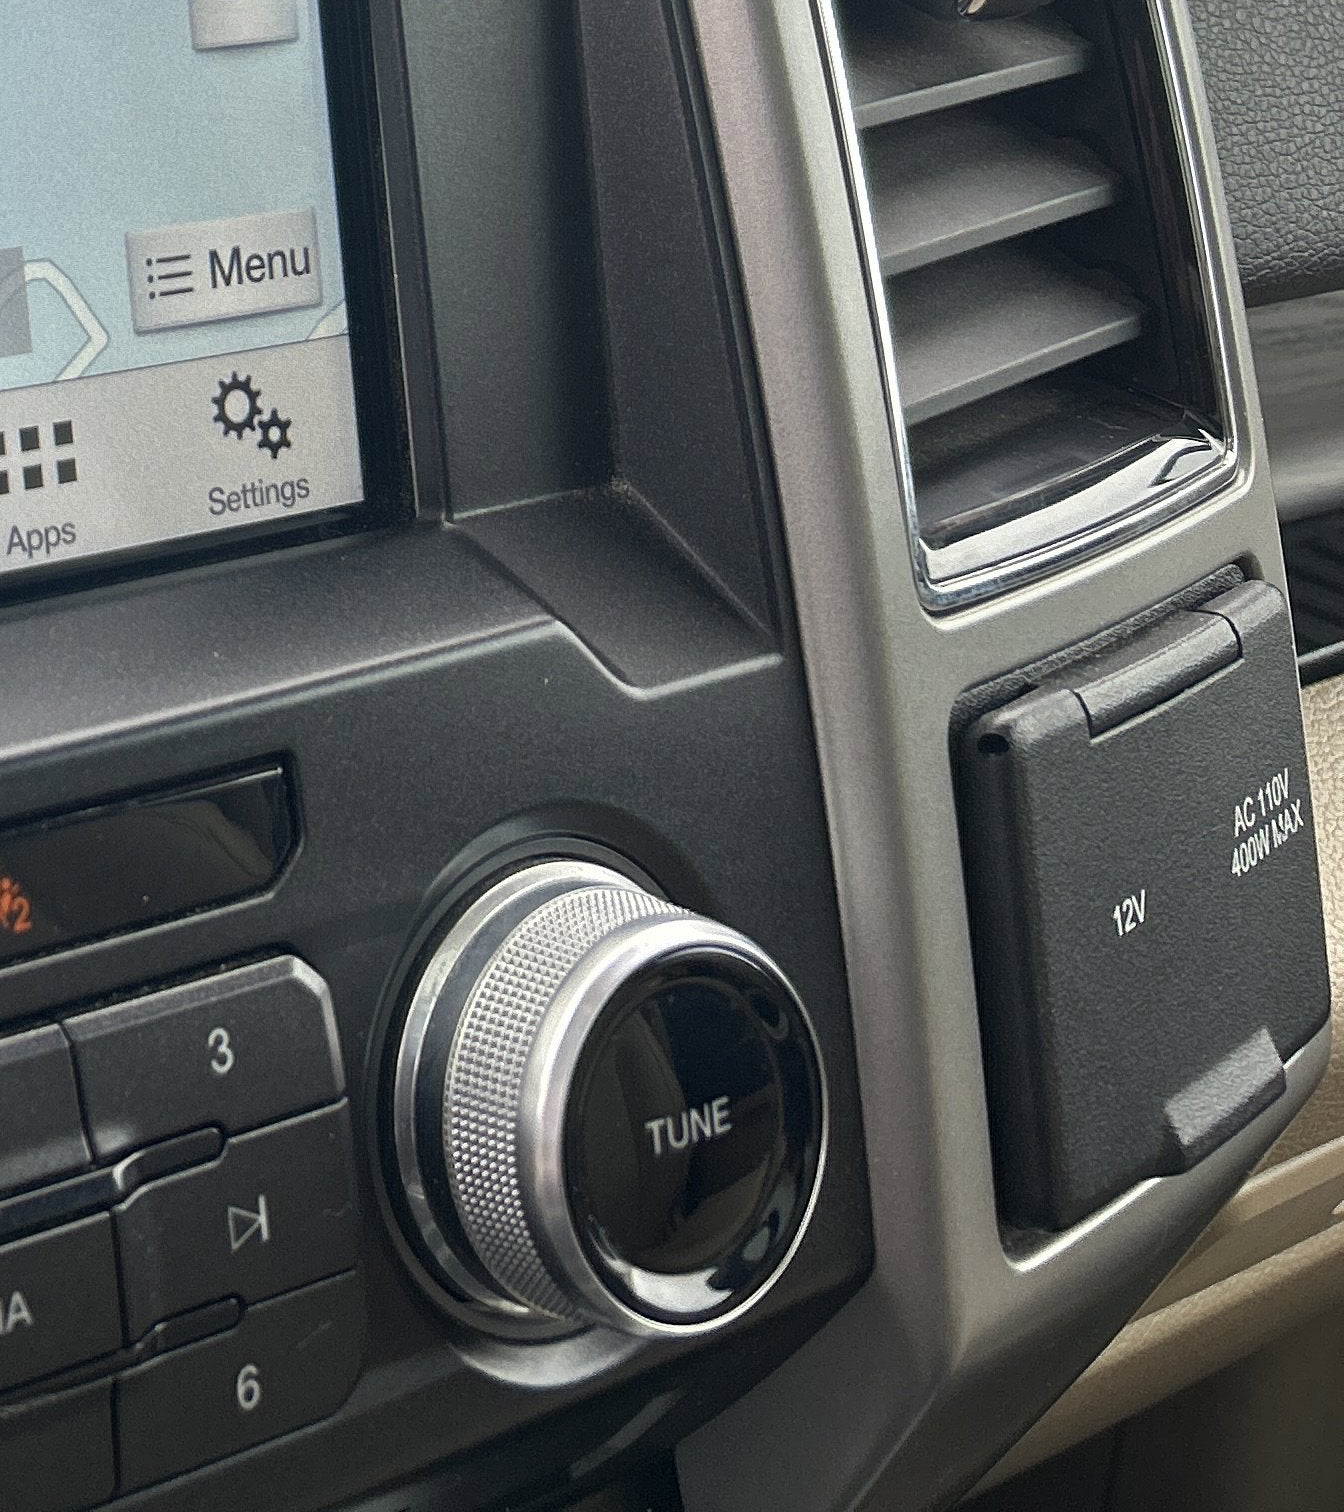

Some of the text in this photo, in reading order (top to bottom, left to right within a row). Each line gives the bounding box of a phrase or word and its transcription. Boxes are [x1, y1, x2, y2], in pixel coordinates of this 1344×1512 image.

[208, 245, 311, 289] Menu
[208, 478, 310, 516] Settings
[6, 521, 78, 559] Apps
[1234, 768, 1290, 838] AC 110V
[1231, 799, 1304, 877] 400W MAX
[1113, 889, 1146, 936] 12V
[208, 1028, 235, 1073] 3
[645, 1095, 732, 1155] TUNE
[236, 1365, 261, 1410] 6
